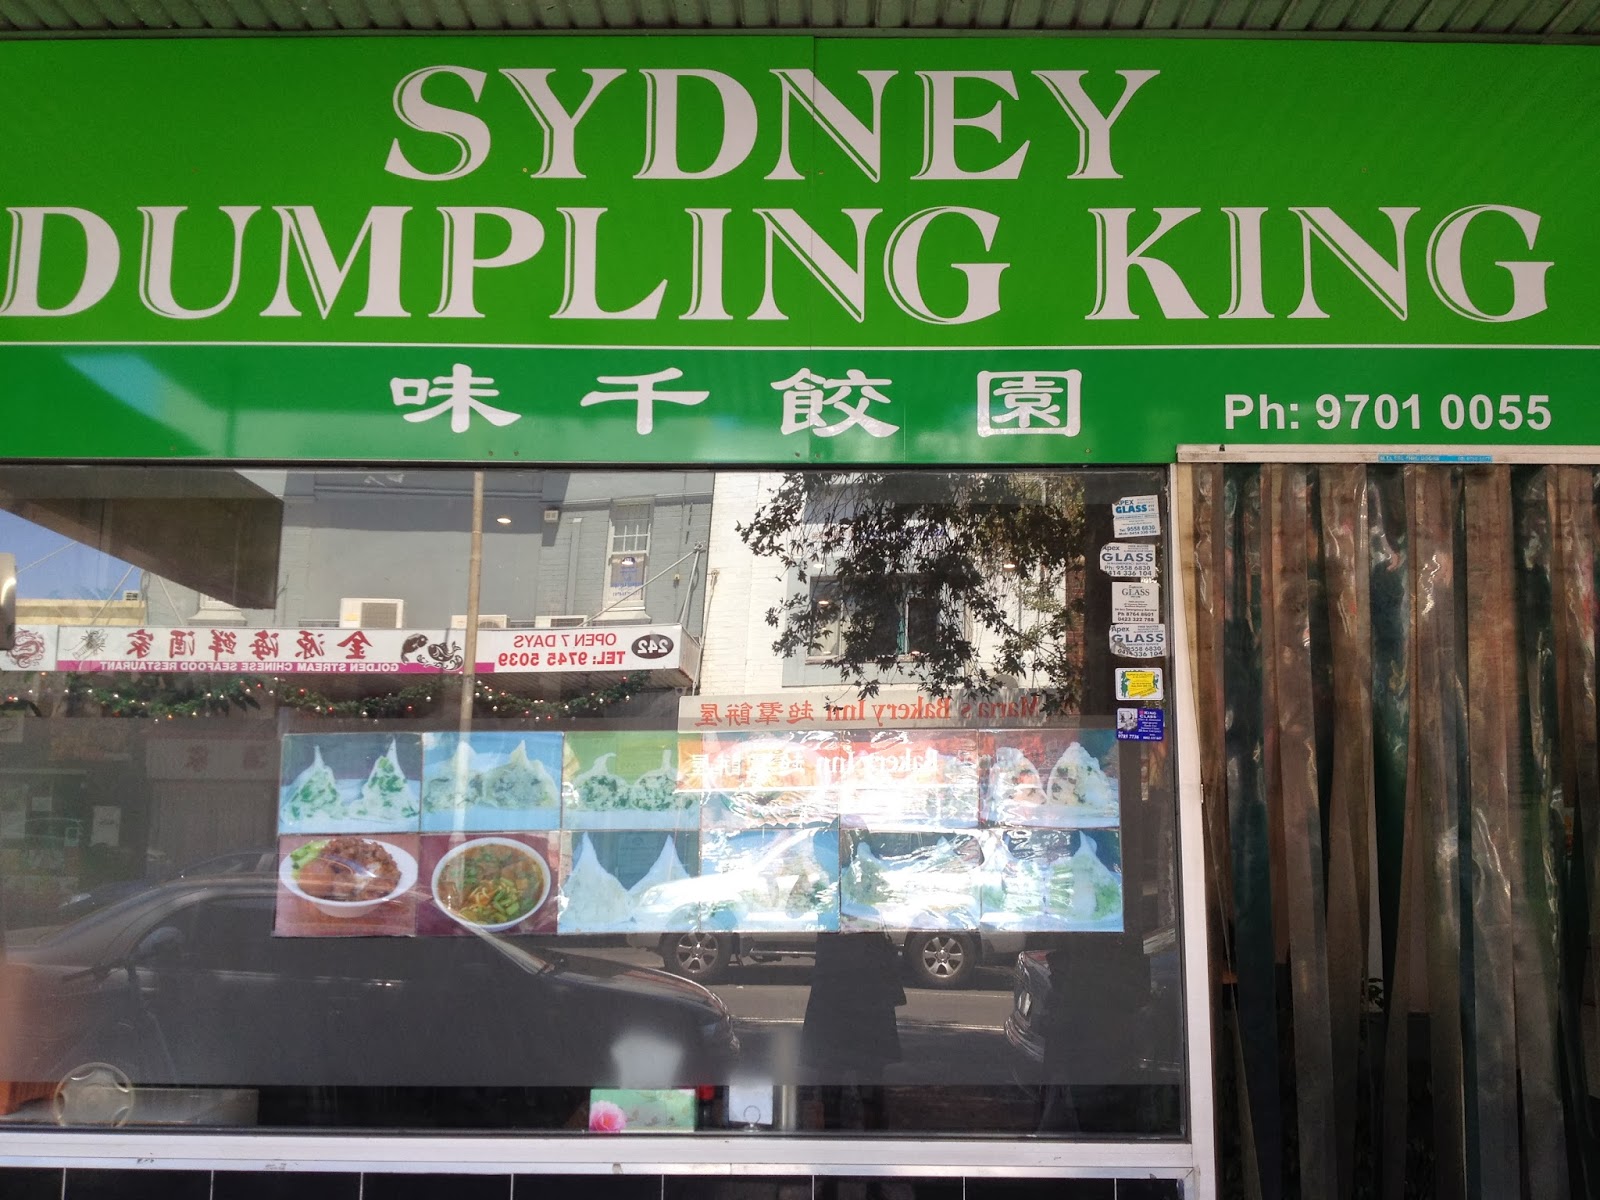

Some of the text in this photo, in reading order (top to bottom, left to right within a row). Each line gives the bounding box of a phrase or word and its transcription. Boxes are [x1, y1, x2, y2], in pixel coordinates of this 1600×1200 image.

[384, 66, 1160, 184] SYDNEY
[0, 204, 1555, 325] DUMPLING KING
[391, 363, 1082, 438] 味千餃園
[1224, 393, 1552, 430] Ph: 9701 0055
[1115, 505, 1148, 513] GLASS
[1101, 553, 1154, 562] GLASS
[1121, 588, 1150, 597] GLASS
[1111, 625, 1130, 633] Apex
[1110, 633, 1164, 643] GLASS
